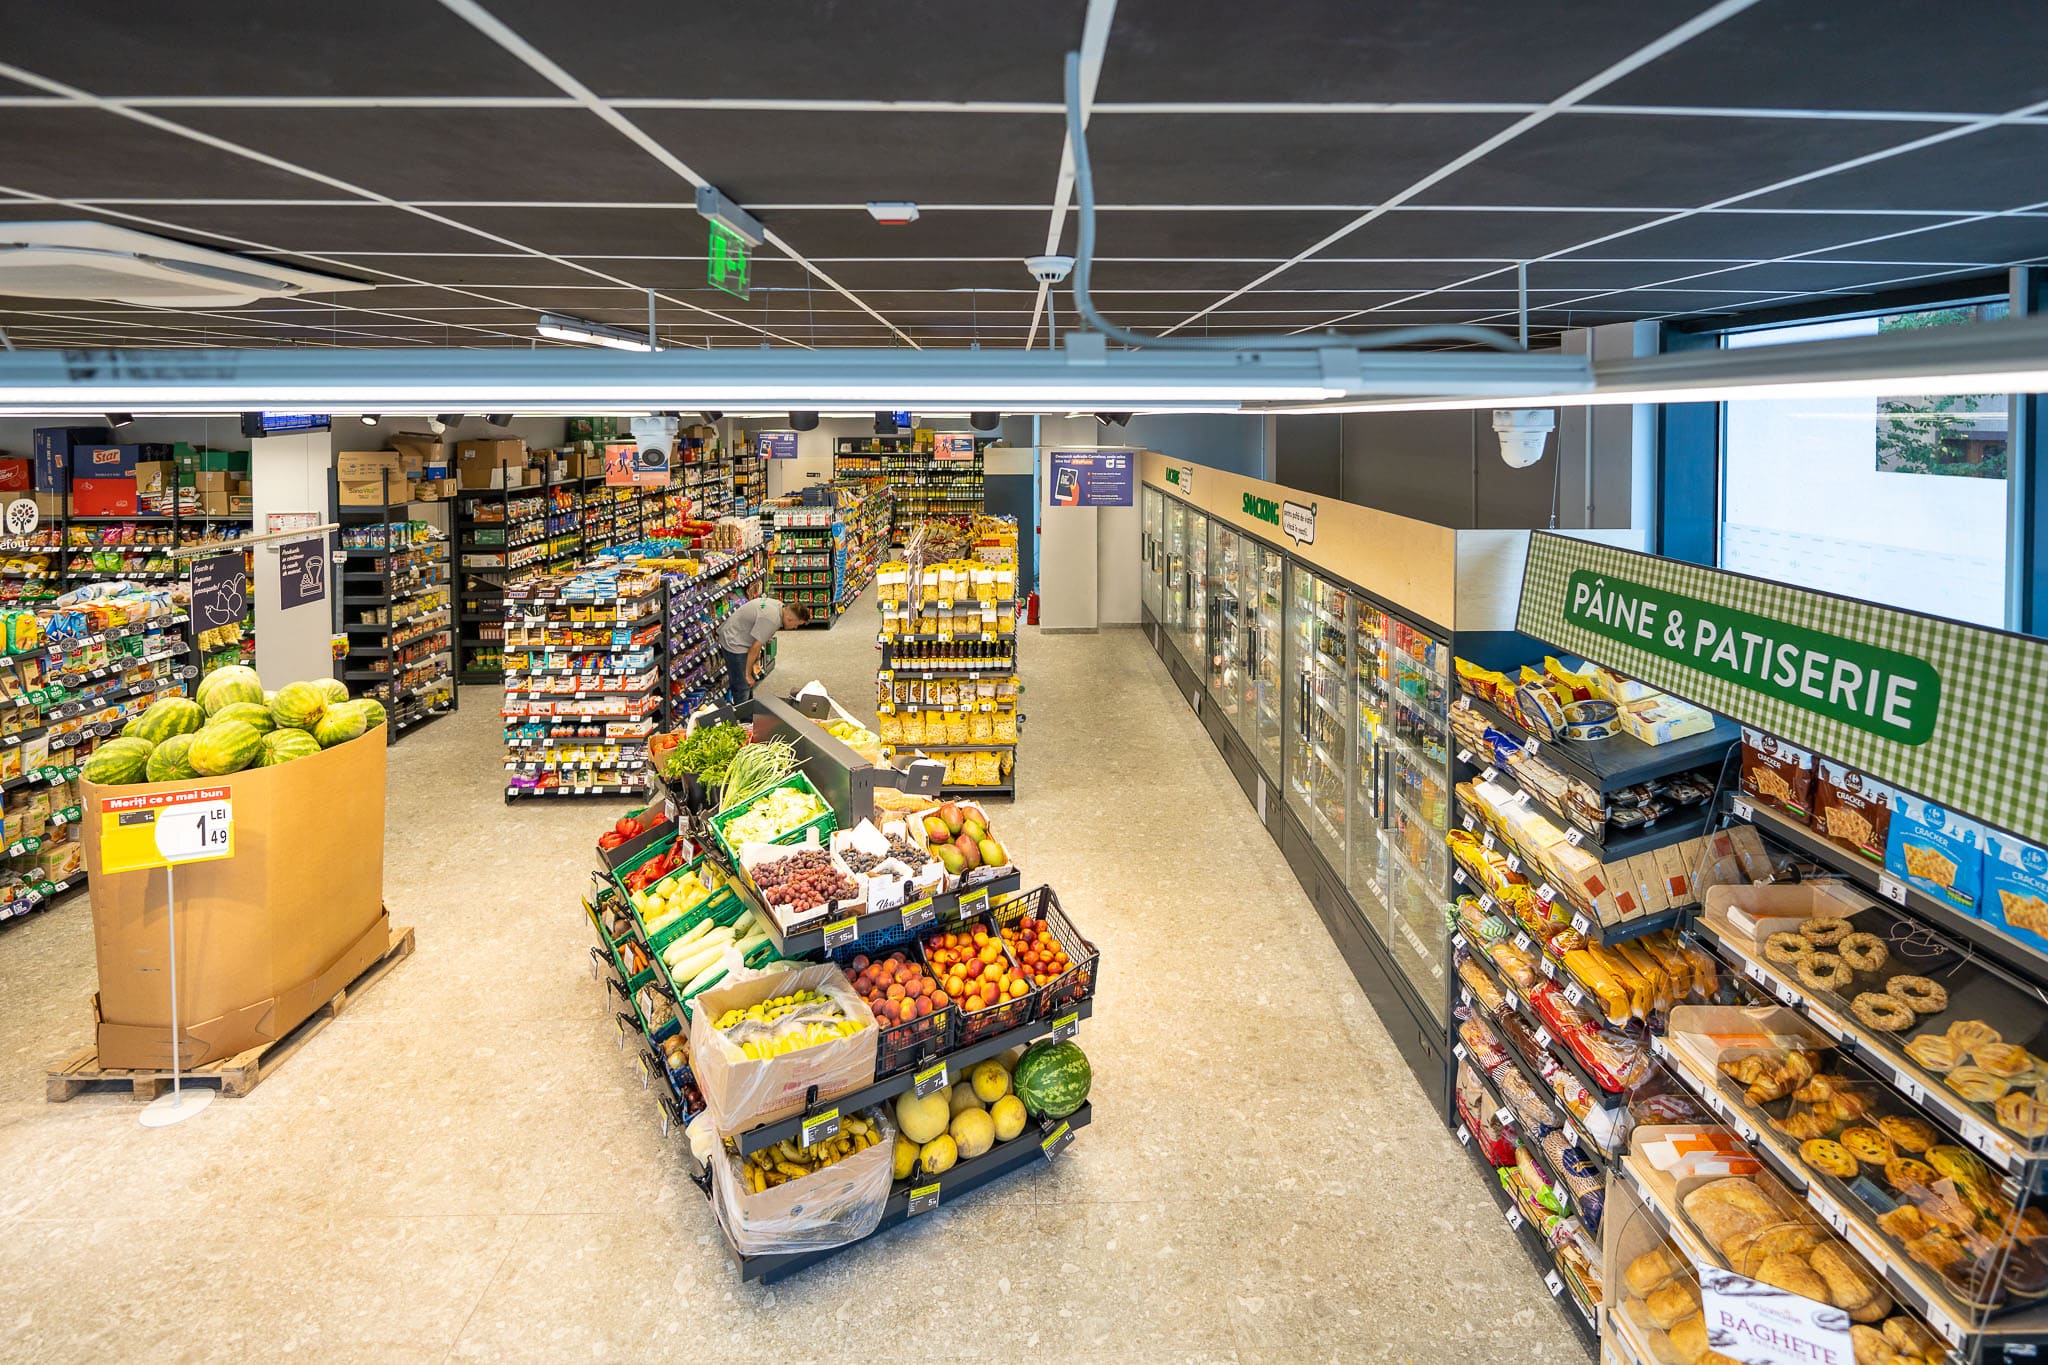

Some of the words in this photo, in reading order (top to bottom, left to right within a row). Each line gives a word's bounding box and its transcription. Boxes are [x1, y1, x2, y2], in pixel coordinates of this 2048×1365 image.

[95, 450, 119, 463] Star
[1242, 492, 1279, 526] SNACKING
[1573, 579, 1658, 640] PÂINE
[1663, 608, 1686, 650] &
[1693, 618, 1919, 730] PATISERIE
[1757, 753, 1782, 769] CRACKER
[149, 796, 163, 804] ce
[176, 791, 198, 801] mai
[200, 790, 223, 798] bun
[1836, 791, 1865, 809] CRACKER
[210, 809, 226, 820] LEI
[197, 815, 206, 846] 1
[211, 830, 227, 844] 49
[1568, 833, 1577, 841] 12
[1914, 826, 1949, 848] CRACKER
[1891, 887, 1898, 899] 5
[1574, 919, 1583, 929] 10
[1518, 937, 1525, 945] 17
[1567, 990, 1576, 1000] 13
[1719, 1310, 1838, 1365] BAGHETE
